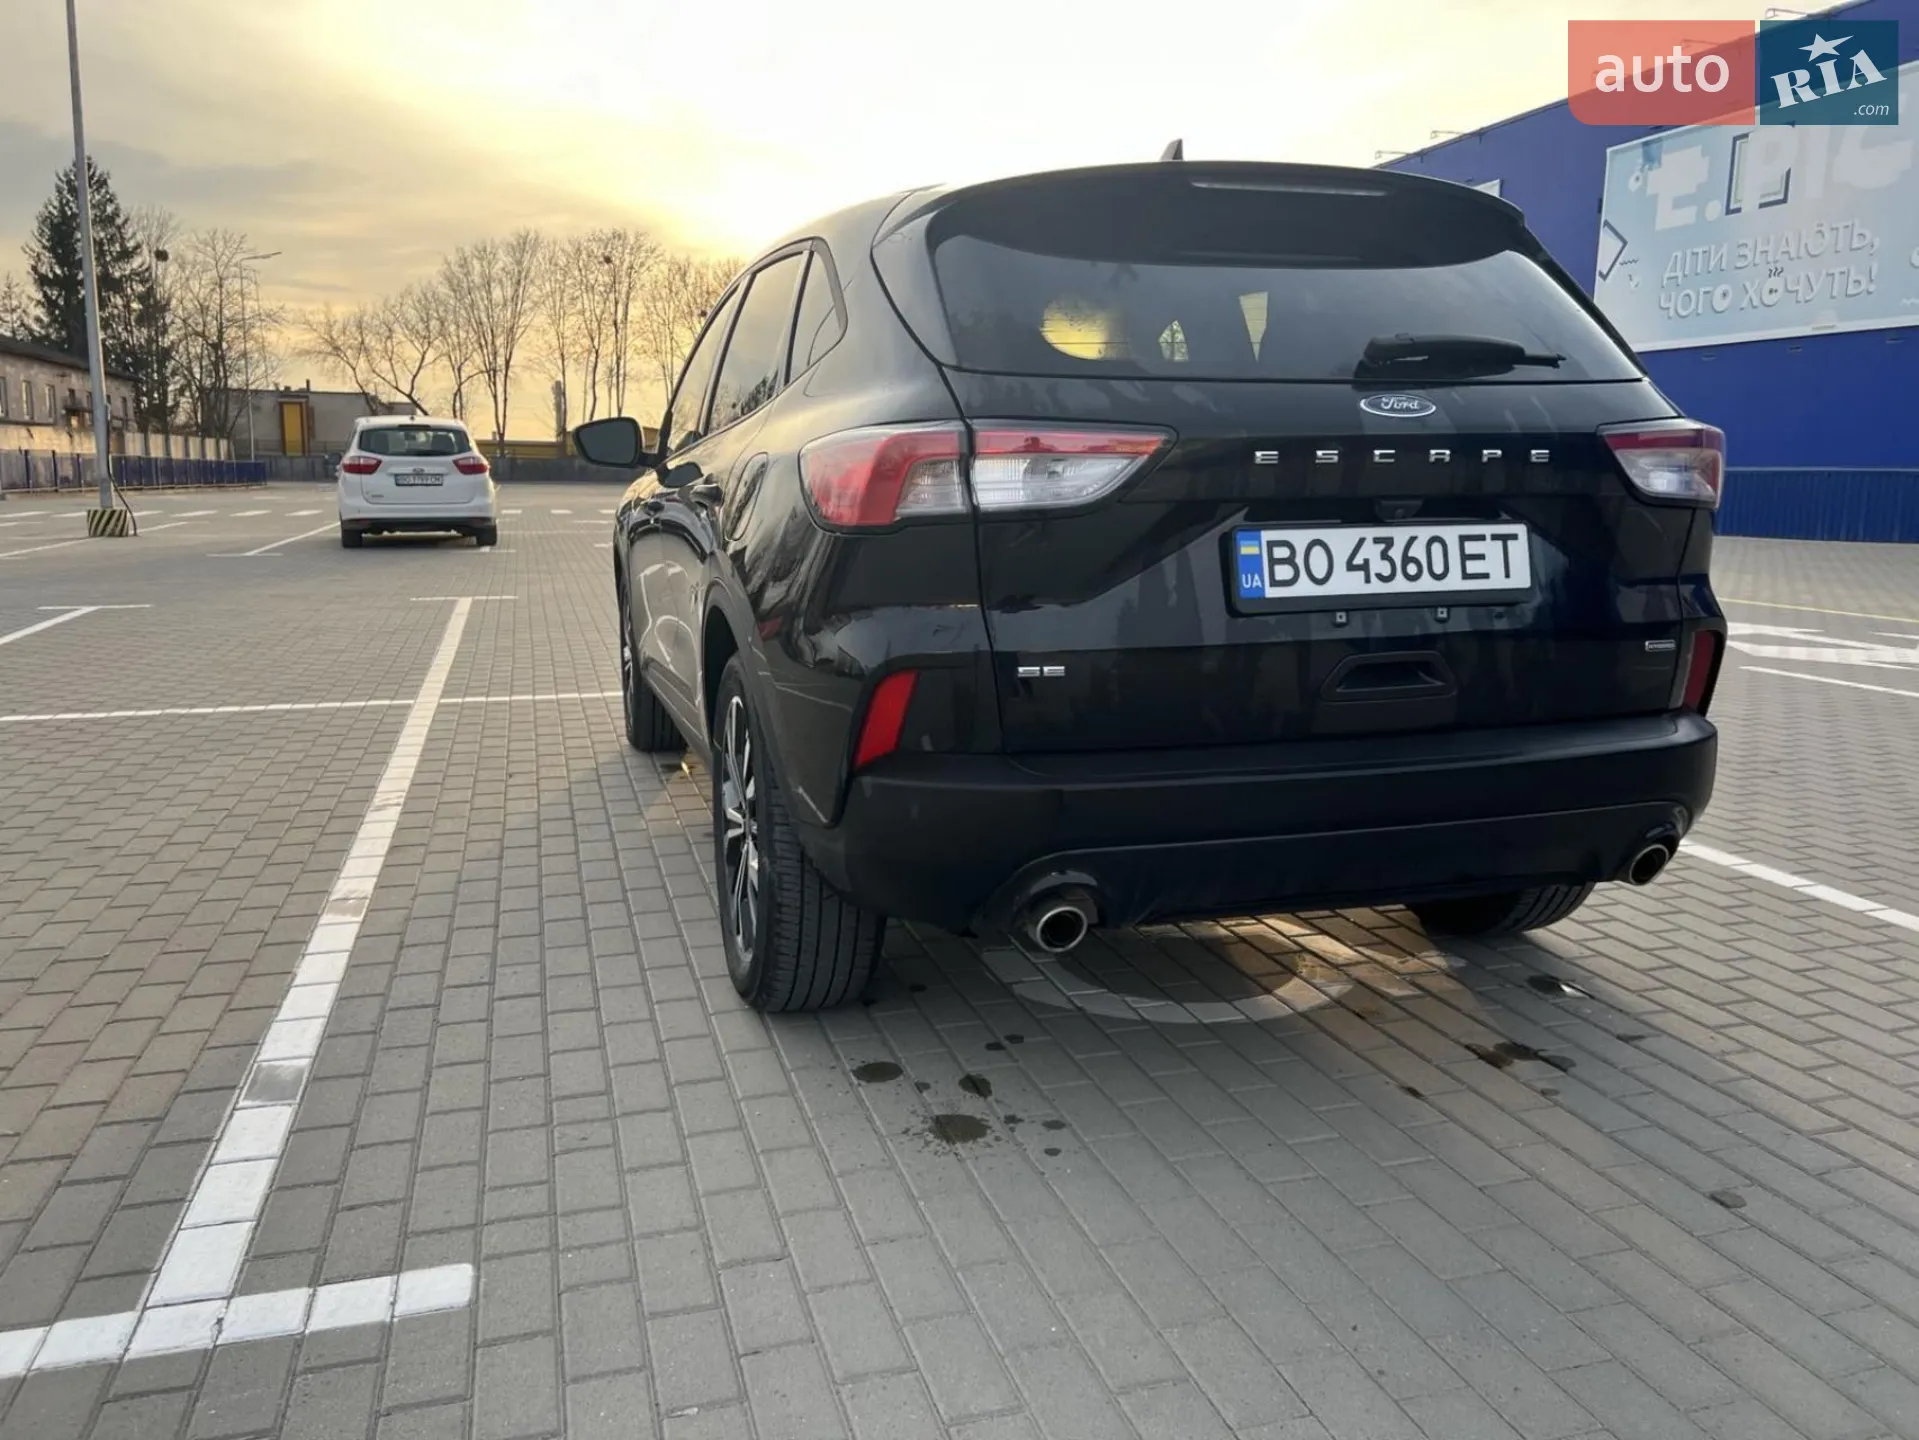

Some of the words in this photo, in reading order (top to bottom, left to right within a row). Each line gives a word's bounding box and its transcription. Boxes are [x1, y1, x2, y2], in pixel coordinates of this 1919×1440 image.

[1662, 244, 1728, 288] ДІТИ
[1658, 284, 1733, 320] ЧОГО
[1380, 396, 1420, 410] Ford
[1254, 449, 1550, 465] ESCAPE
[1345, 534, 1450, 584] 4360
[1242, 573, 1263, 590] UA
